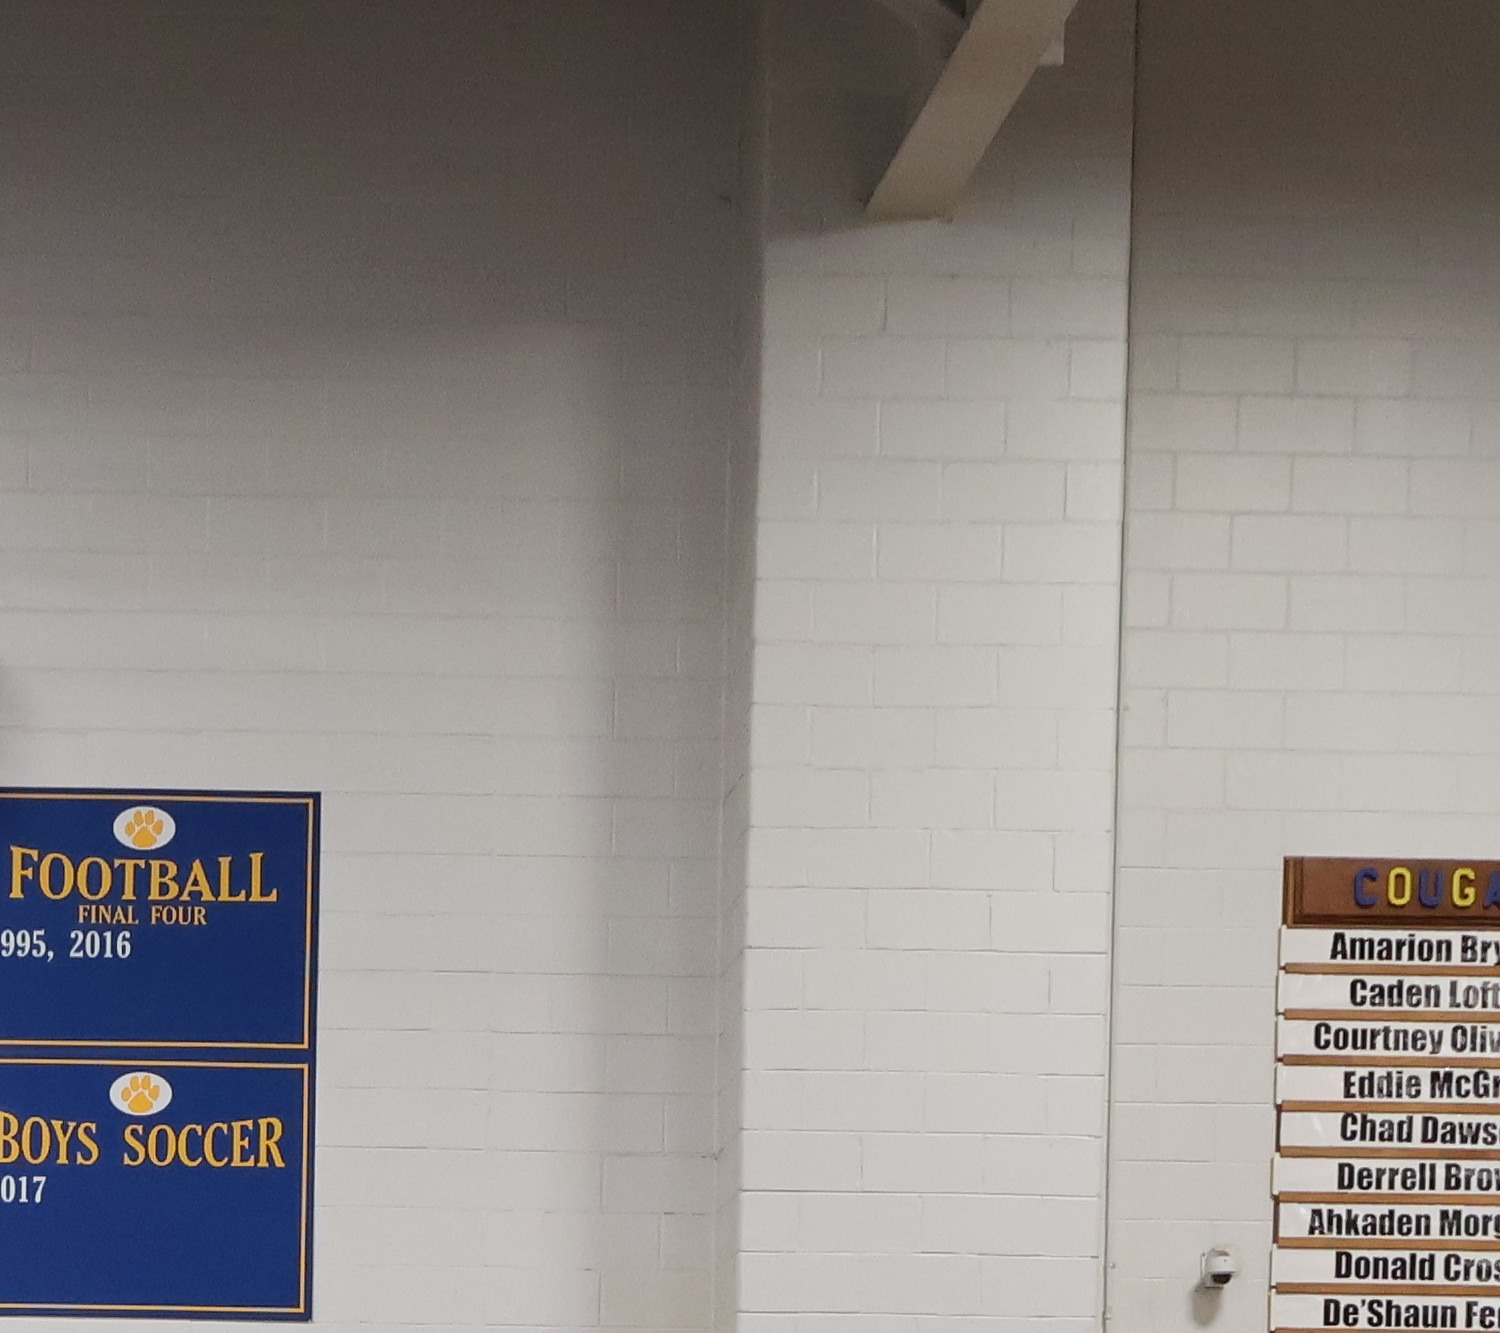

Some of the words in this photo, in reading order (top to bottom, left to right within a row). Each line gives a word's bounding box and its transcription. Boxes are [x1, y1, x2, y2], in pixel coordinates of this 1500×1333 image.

[9, 846, 277, 902] FOOTBALL
[79, 905, 139, 924] FINAL
[151, 905, 206, 925] FOUR
[70, 930, 130, 958] 2016
[1330, 932, 1452, 962] Amarion
[1350, 979, 1440, 1008] Caden
[1314, 1022, 1443, 1054] Courtney
[1344, 1071, 1421, 1099] Eddie
[124, 1118, 285, 1167] SOCCER
[1340, 1113, 1413, 1143] Chad
[1338, 1163, 1436, 1191] Derrell
[1308, 1209, 1431, 1236] Ahkaden
[1335, 1251, 1435, 1280] Donald
